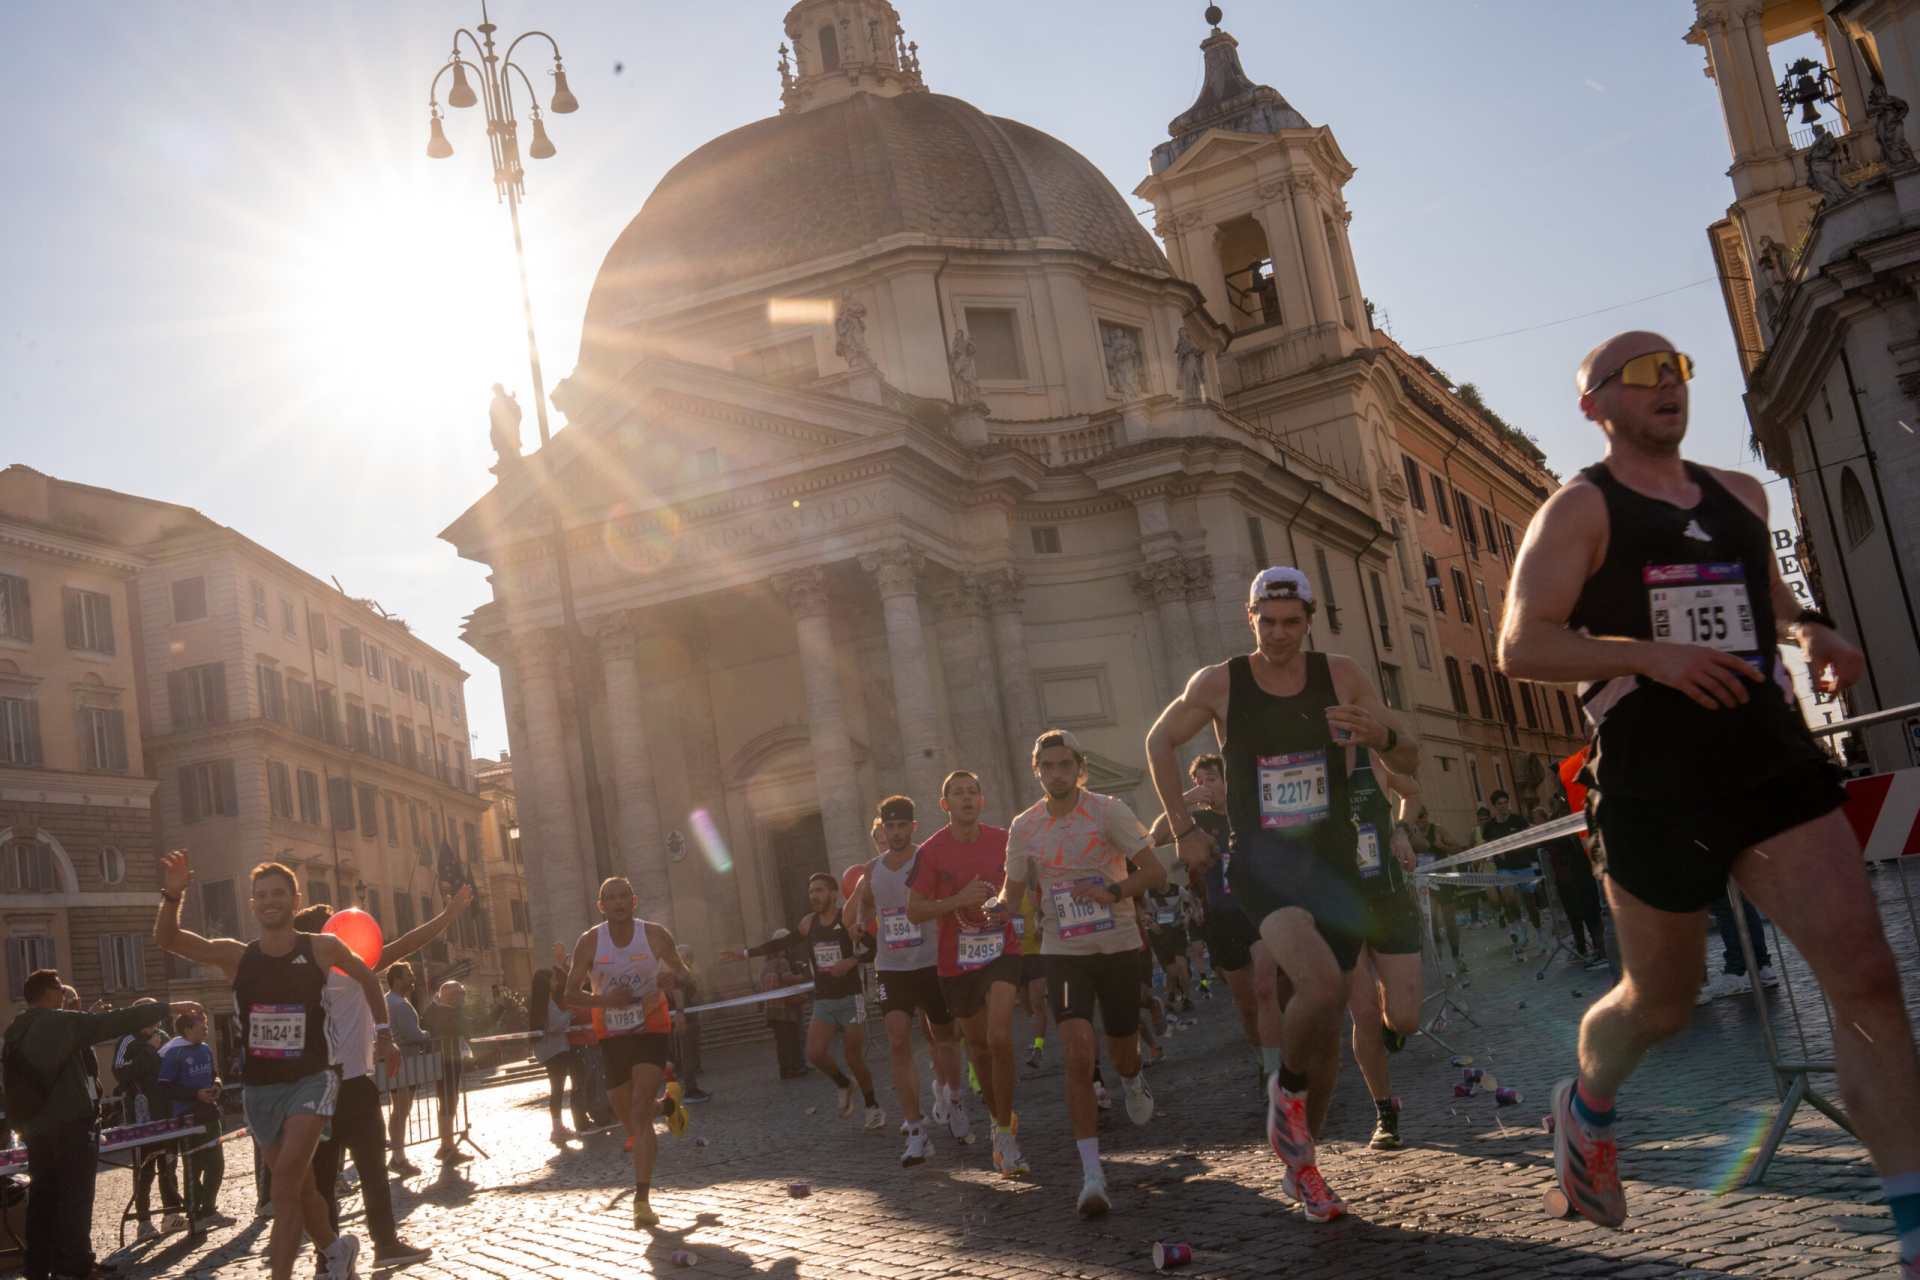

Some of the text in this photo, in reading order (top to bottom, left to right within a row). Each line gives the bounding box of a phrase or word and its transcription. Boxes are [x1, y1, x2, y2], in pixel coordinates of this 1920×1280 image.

[1686, 605, 1728, 642] 155
[1283, 769, 1302, 778] GREGOR
[1277, 779, 1311, 805] 2217
[893, 922, 911, 936] 594
[967, 943, 995, 959] 2495
[613, 1012, 636, 1026] 1782
